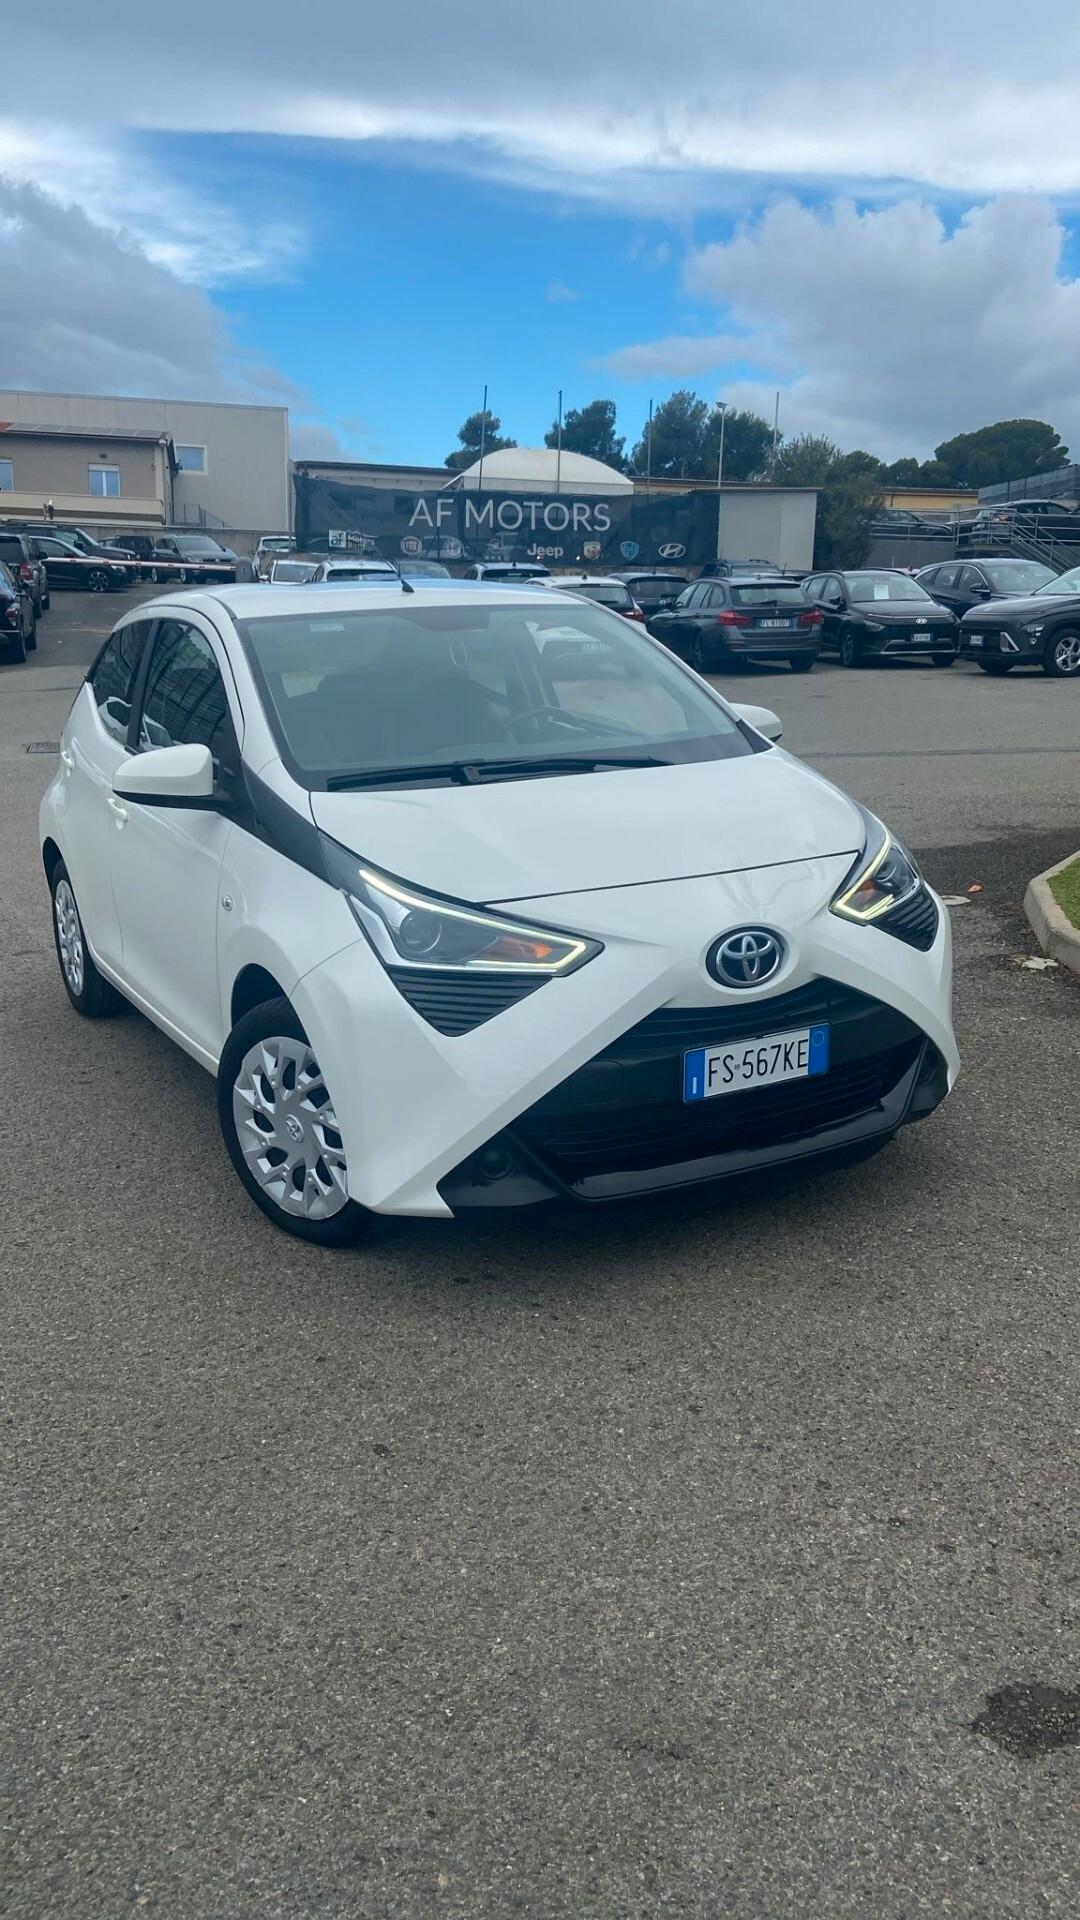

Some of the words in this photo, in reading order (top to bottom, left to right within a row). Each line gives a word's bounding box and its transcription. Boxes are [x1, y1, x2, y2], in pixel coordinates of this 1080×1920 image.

[408, 498, 454, 527] AF
[465, 499, 611, 532] MOTORS
[527, 543, 564, 559] Jeep
